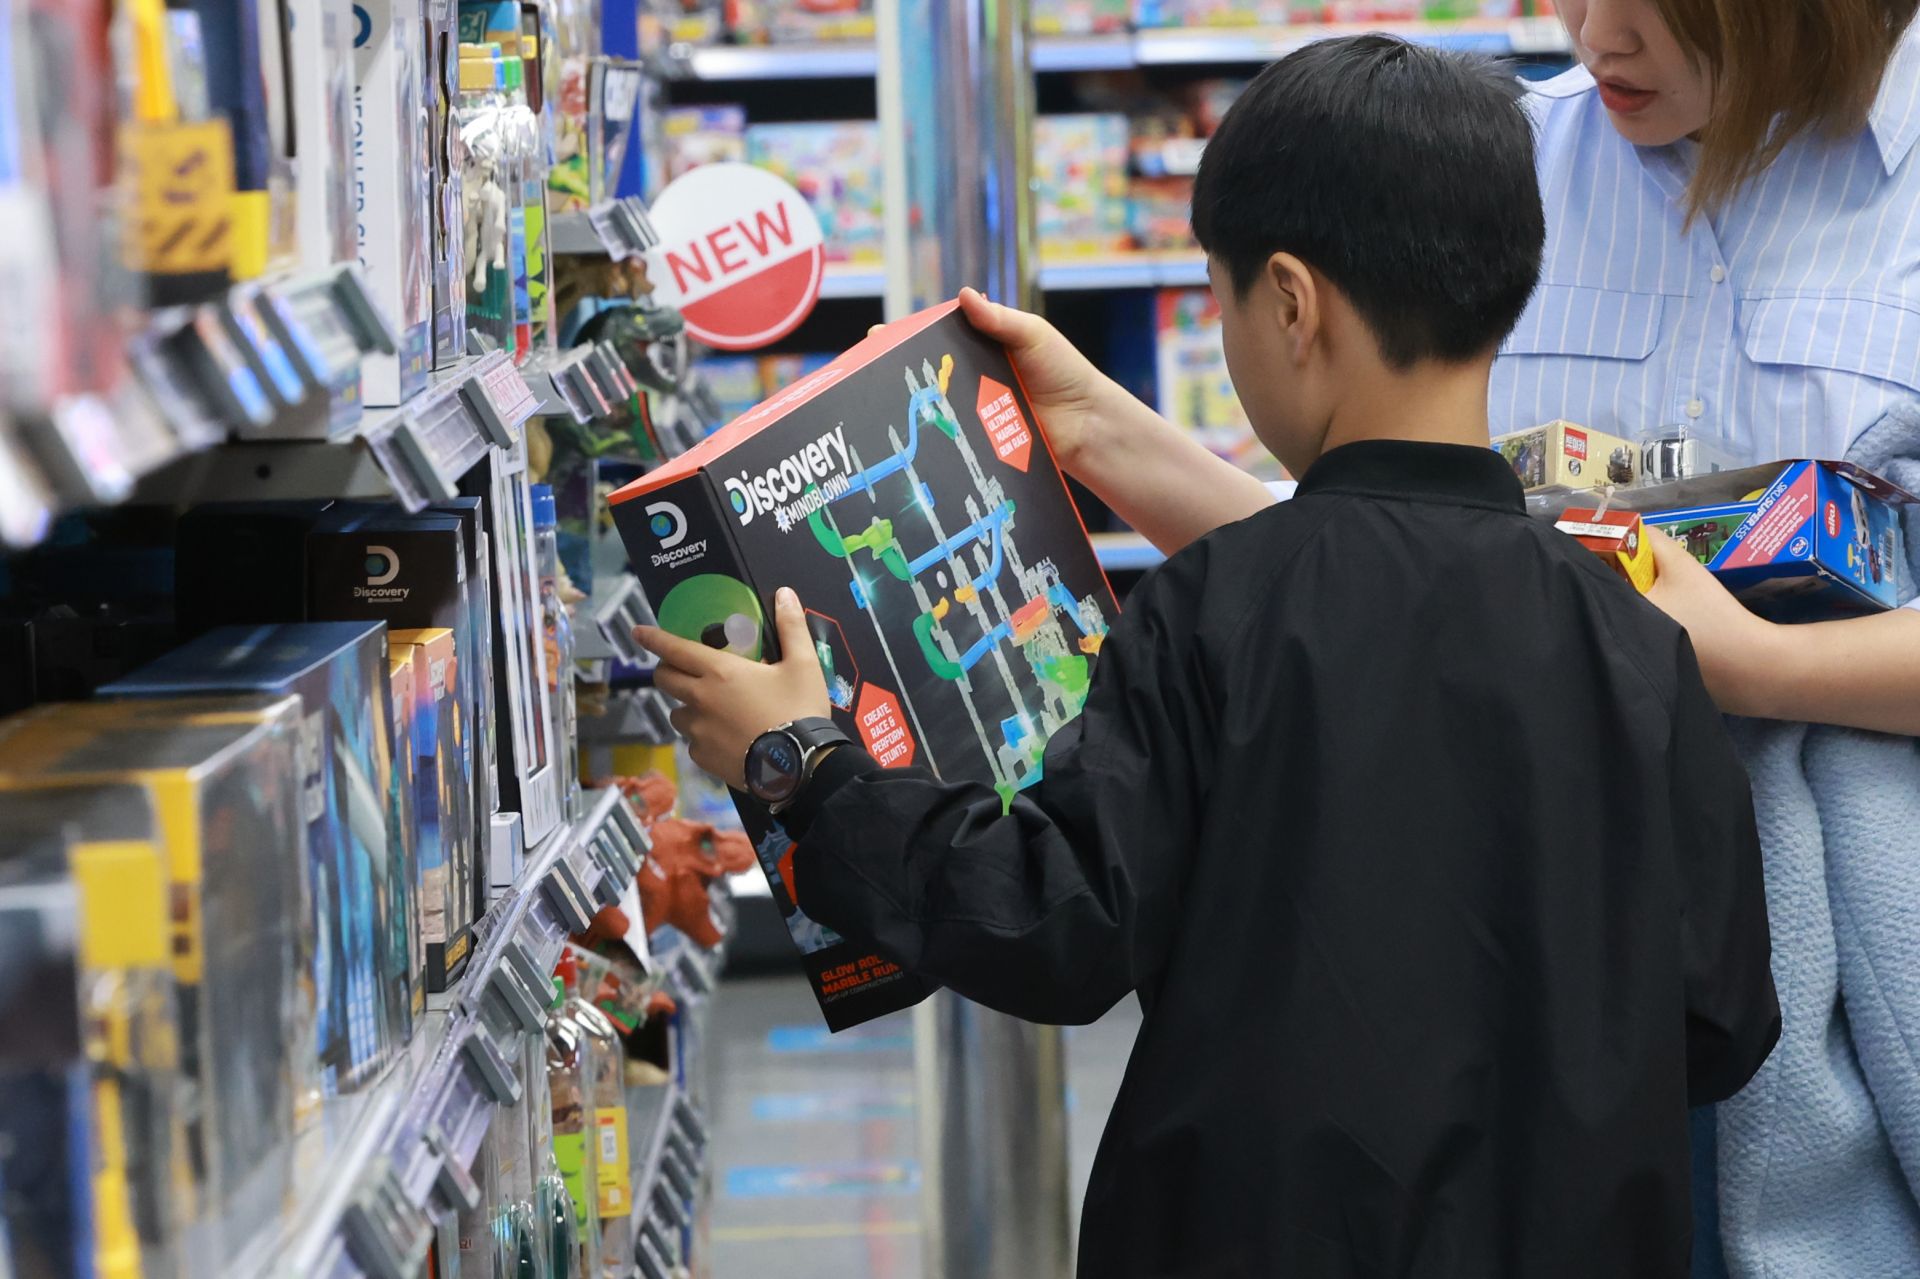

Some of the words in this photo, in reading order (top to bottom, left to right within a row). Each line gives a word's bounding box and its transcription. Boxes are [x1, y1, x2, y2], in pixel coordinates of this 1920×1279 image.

[665, 200, 793, 295] NEW
[981, 400, 1001, 419] BUILD
[998, 392, 1012, 407] THE
[987, 405, 1017, 431] ULTIMATE
[995, 419, 1021, 443] MARBLE
[999, 441, 1015, 457] RUN
[1011, 431, 1029, 449] RACE
[724, 425, 852, 527] Discovery
[1828, 503, 1836, 535] siku
[651, 539, 707, 567] Discovery
[353, 586, 410, 599] Discovery
[870, 719, 891, 739] RACE
[888, 716, 896, 727] &
[872, 726, 905, 755] PERFORM
[880, 741, 908, 767] STUNTS
[821, 962, 855, 981] GLOW
[822, 971, 871, 995] MARBLE
